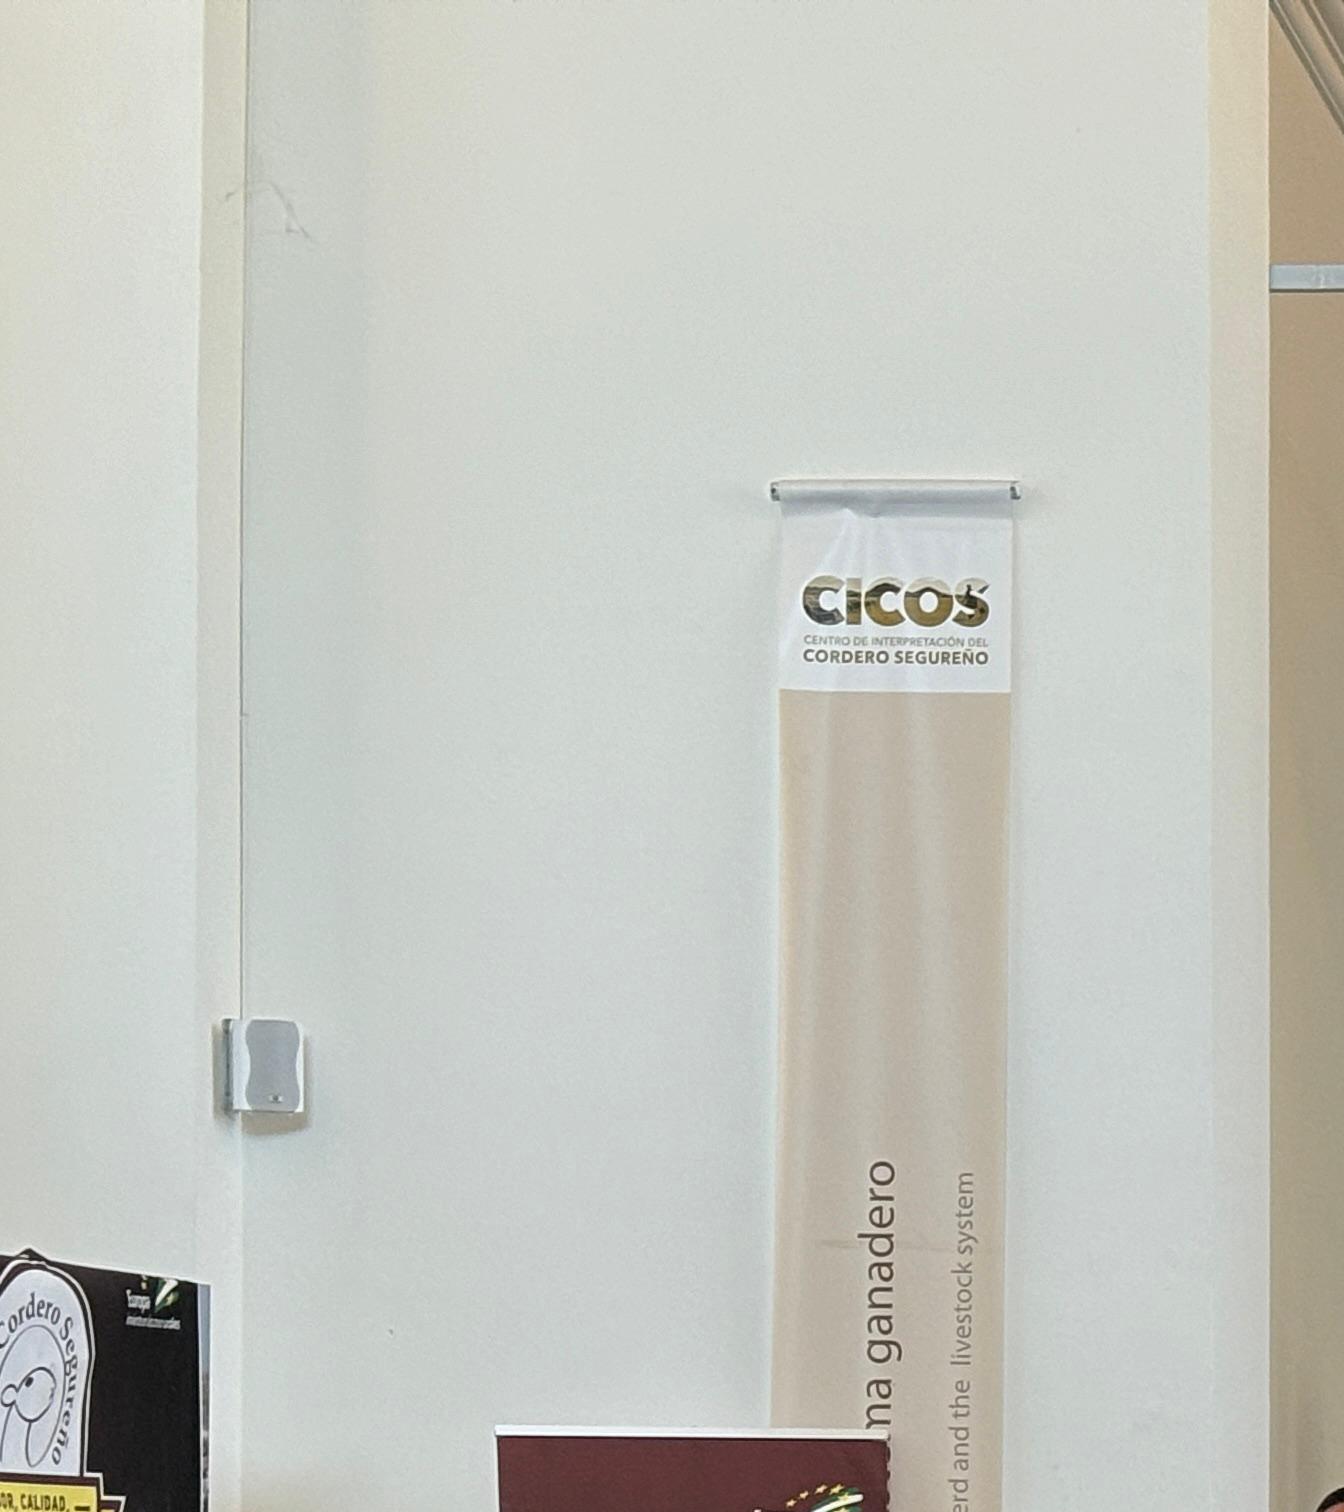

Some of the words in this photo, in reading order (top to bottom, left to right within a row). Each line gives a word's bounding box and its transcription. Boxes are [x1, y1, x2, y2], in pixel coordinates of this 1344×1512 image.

[802, 575, 990, 627] CICOS
[803, 649, 889, 663] CORDERO
[894, 649, 988, 664] SEGUREÑO
[804, 635, 850, 647] CENTRO
[853, 636, 869, 646] DE
[871, 636, 964, 647] INTERPRETACIÓN
[968, 638, 988, 647] DEL
[957, 1171, 978, 1256] system
[857, 1160, 903, 1364] ganadero
[950, 1261, 973, 1367] livestock
[52, 1316, 78, 1465] Segureño
[948, 1379, 970, 1419] the
[948, 1426, 970, 1471] and
